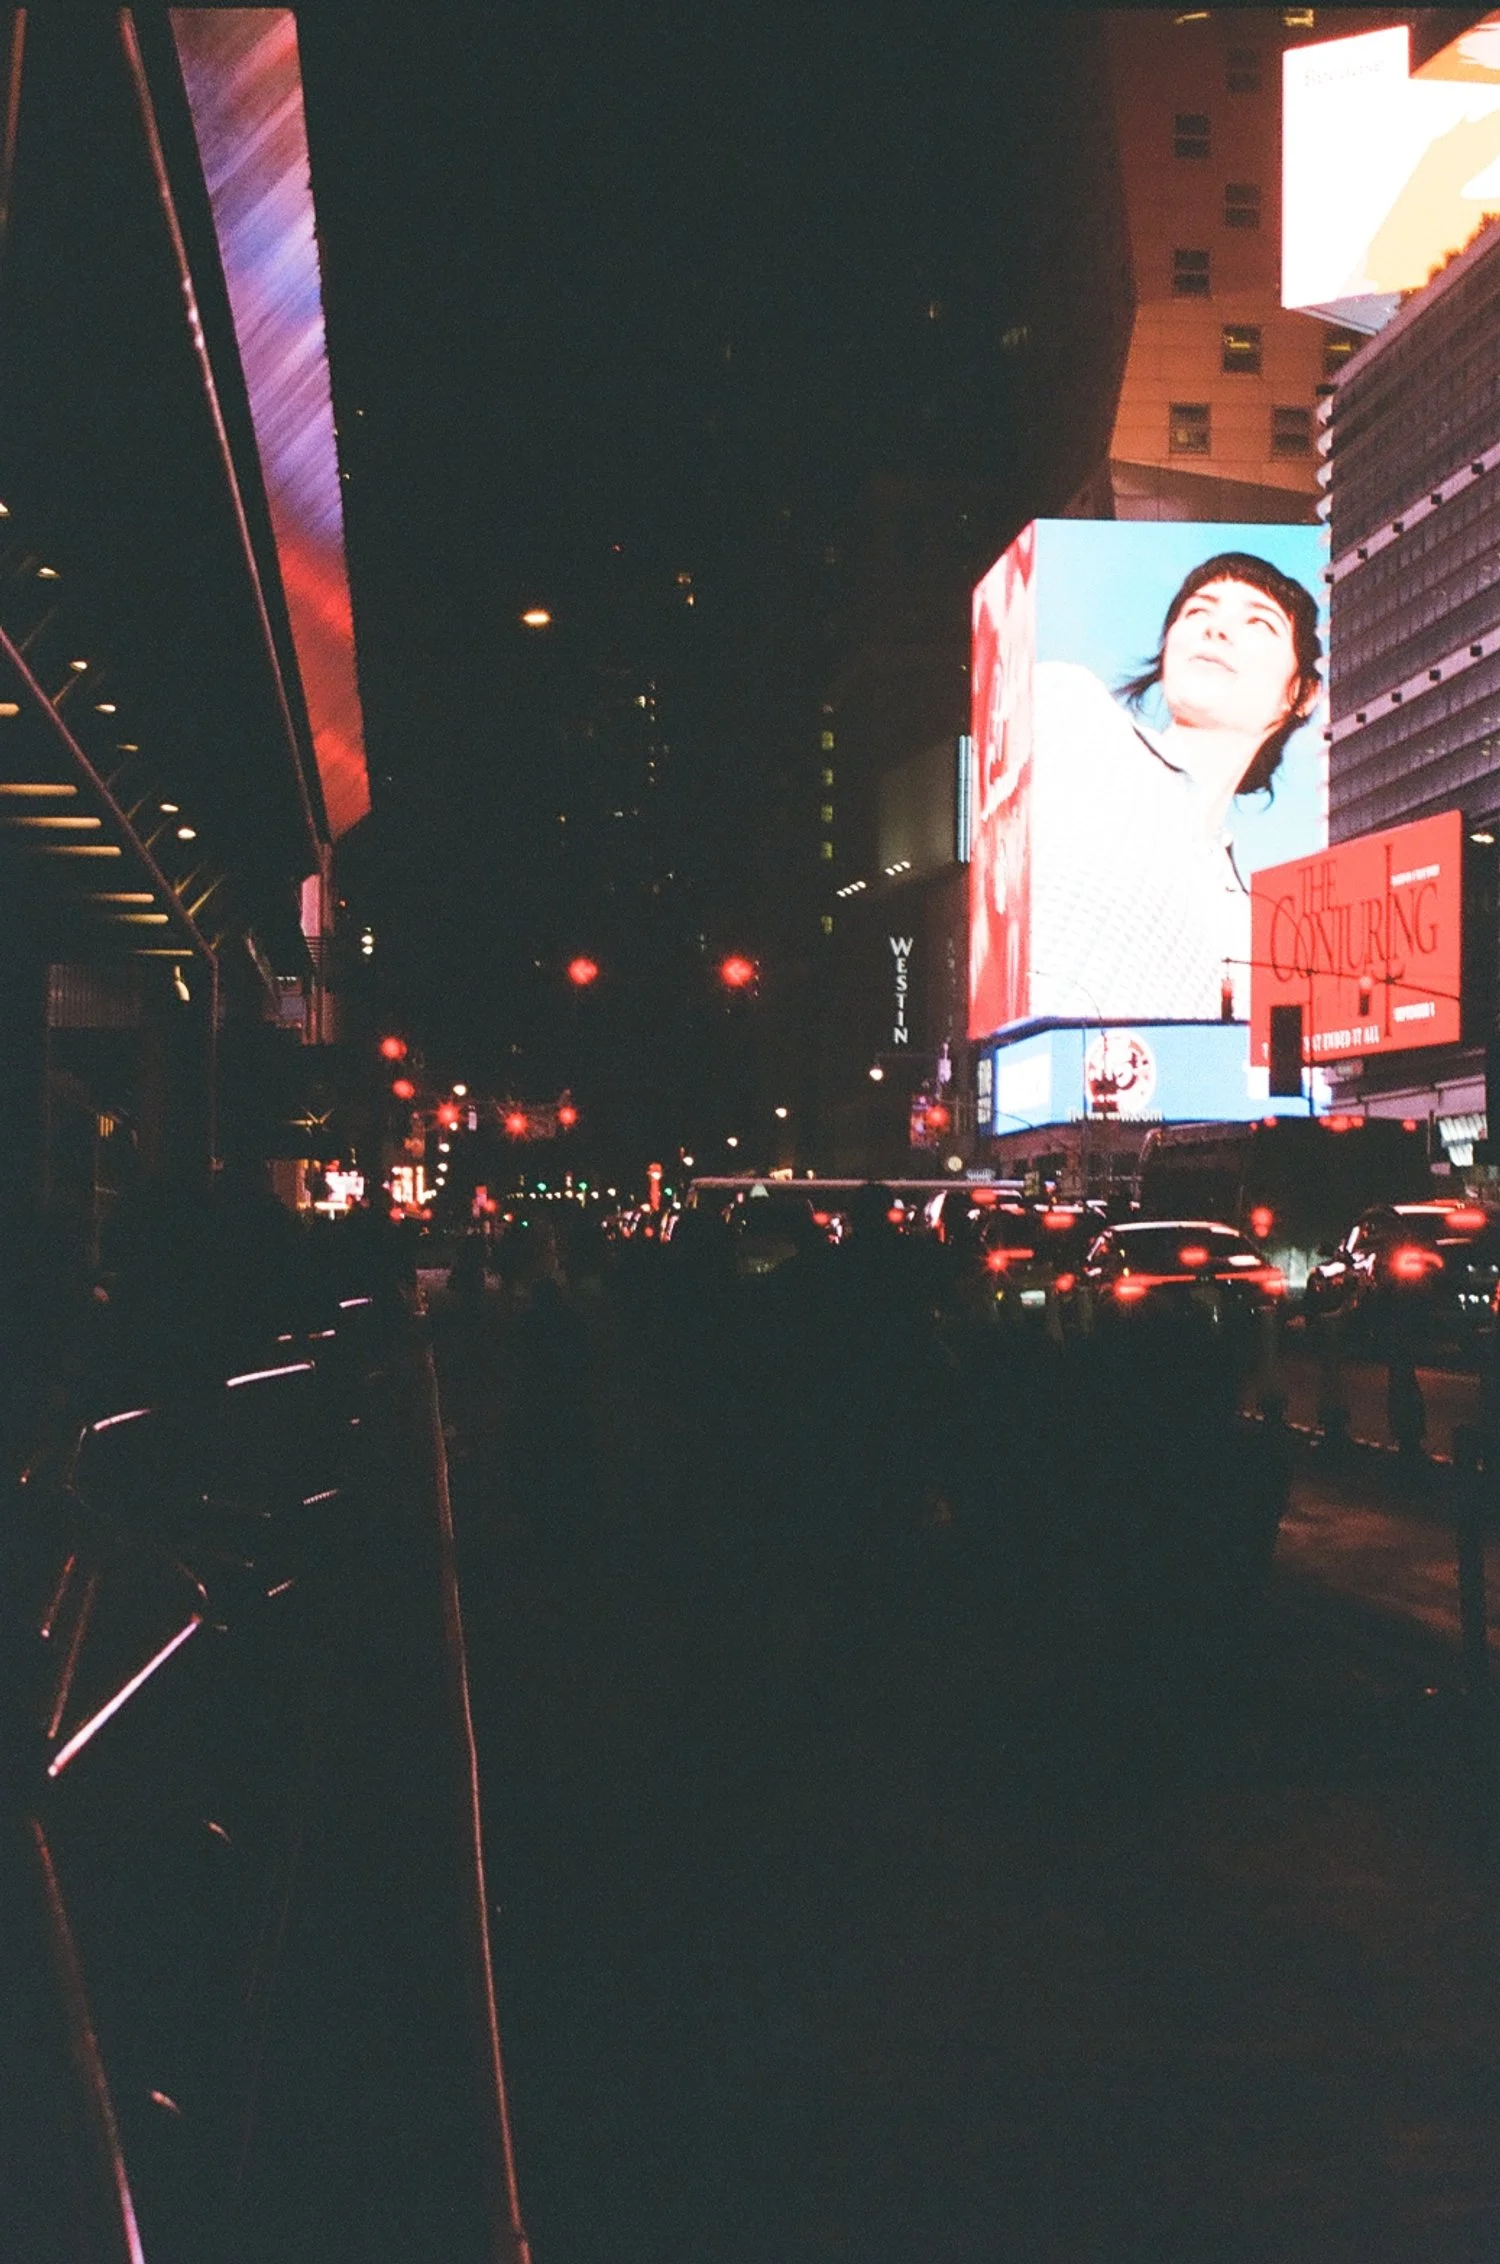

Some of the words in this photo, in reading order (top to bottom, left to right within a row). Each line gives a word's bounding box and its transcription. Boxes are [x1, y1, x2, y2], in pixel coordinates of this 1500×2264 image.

[1270, 850, 1438, 985] CONJURING
[1297, 860, 1336, 913] THE
[889, 936, 914, 1044] WESTIN
[1351, 1027, 1363, 1047] IT
[1364, 1025, 1380, 1044] ALL
